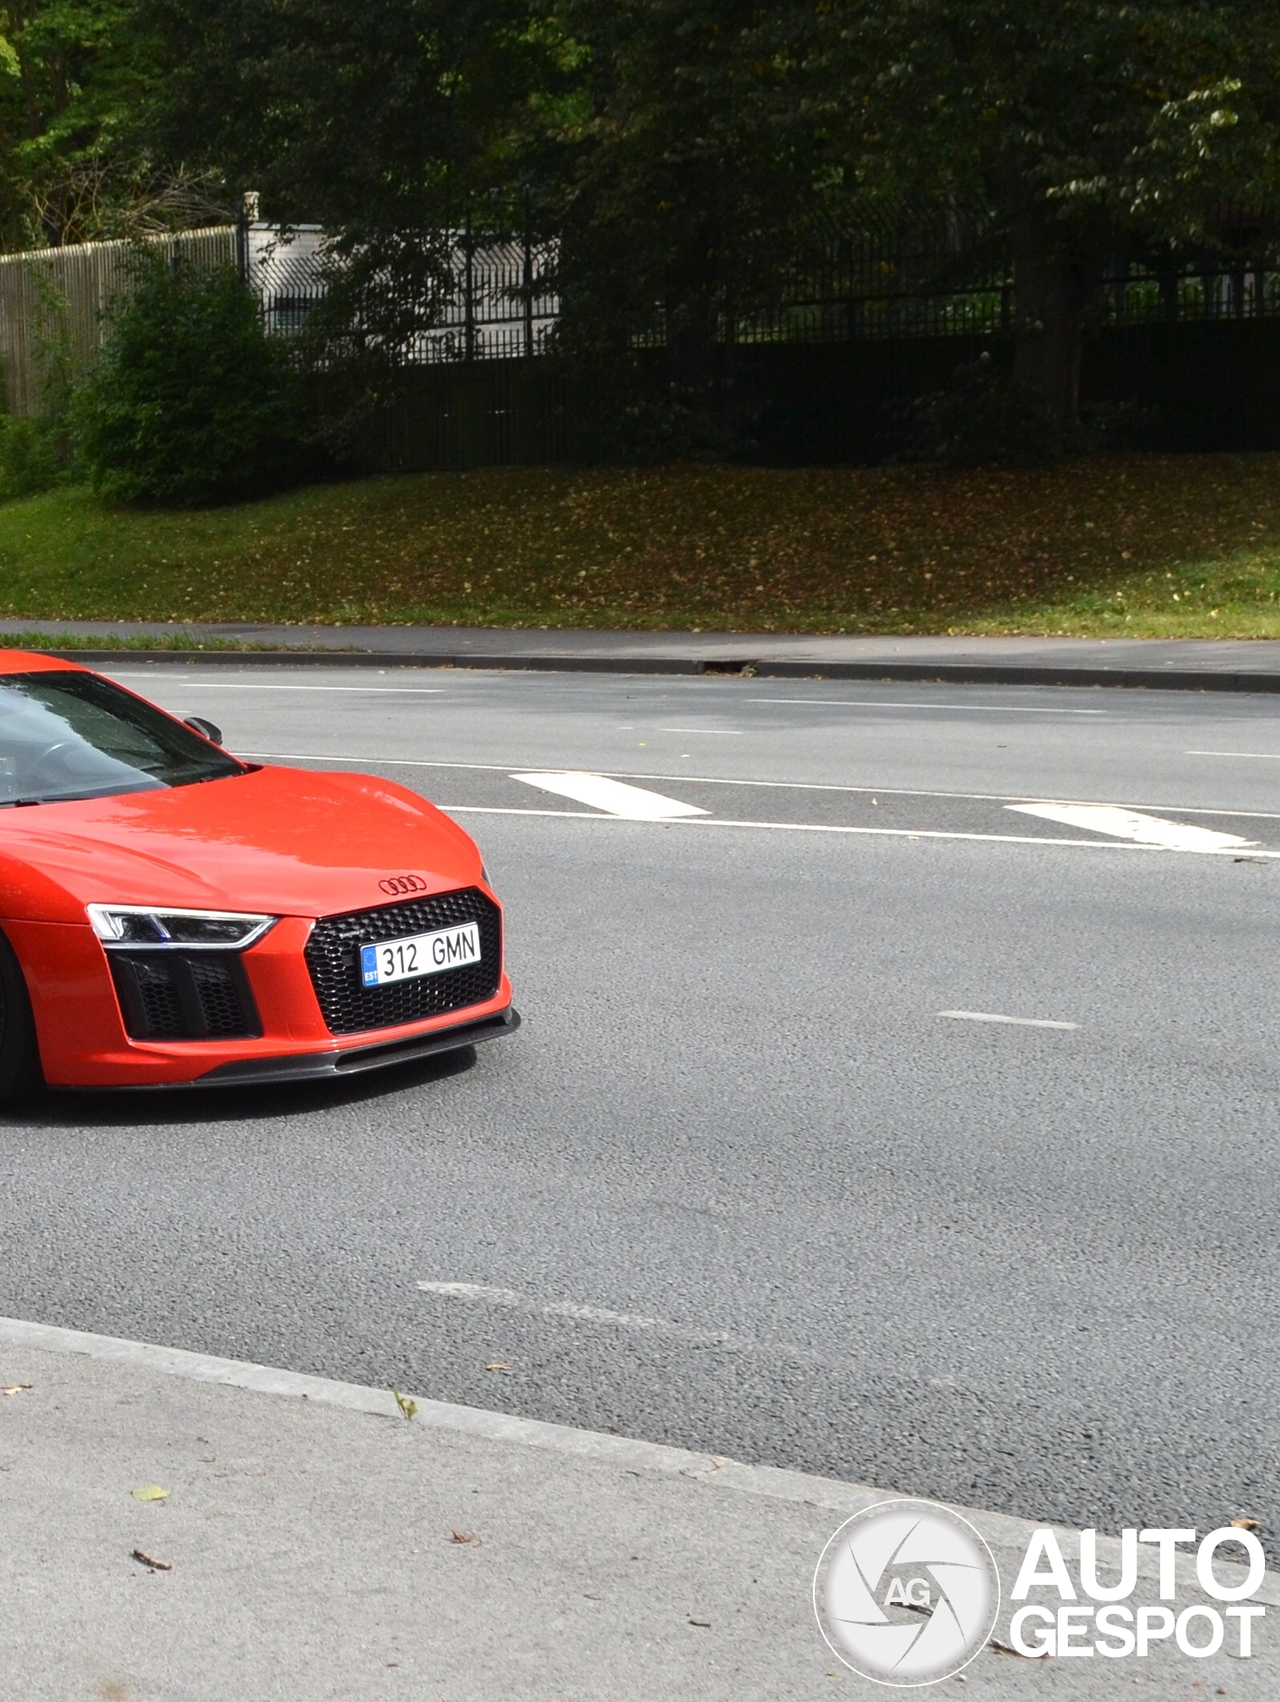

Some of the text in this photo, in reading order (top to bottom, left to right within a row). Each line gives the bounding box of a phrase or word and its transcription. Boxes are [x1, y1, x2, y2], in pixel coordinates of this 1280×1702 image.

[382, 930, 475, 977] 312 GMN
[365, 971, 378, 981] EST
